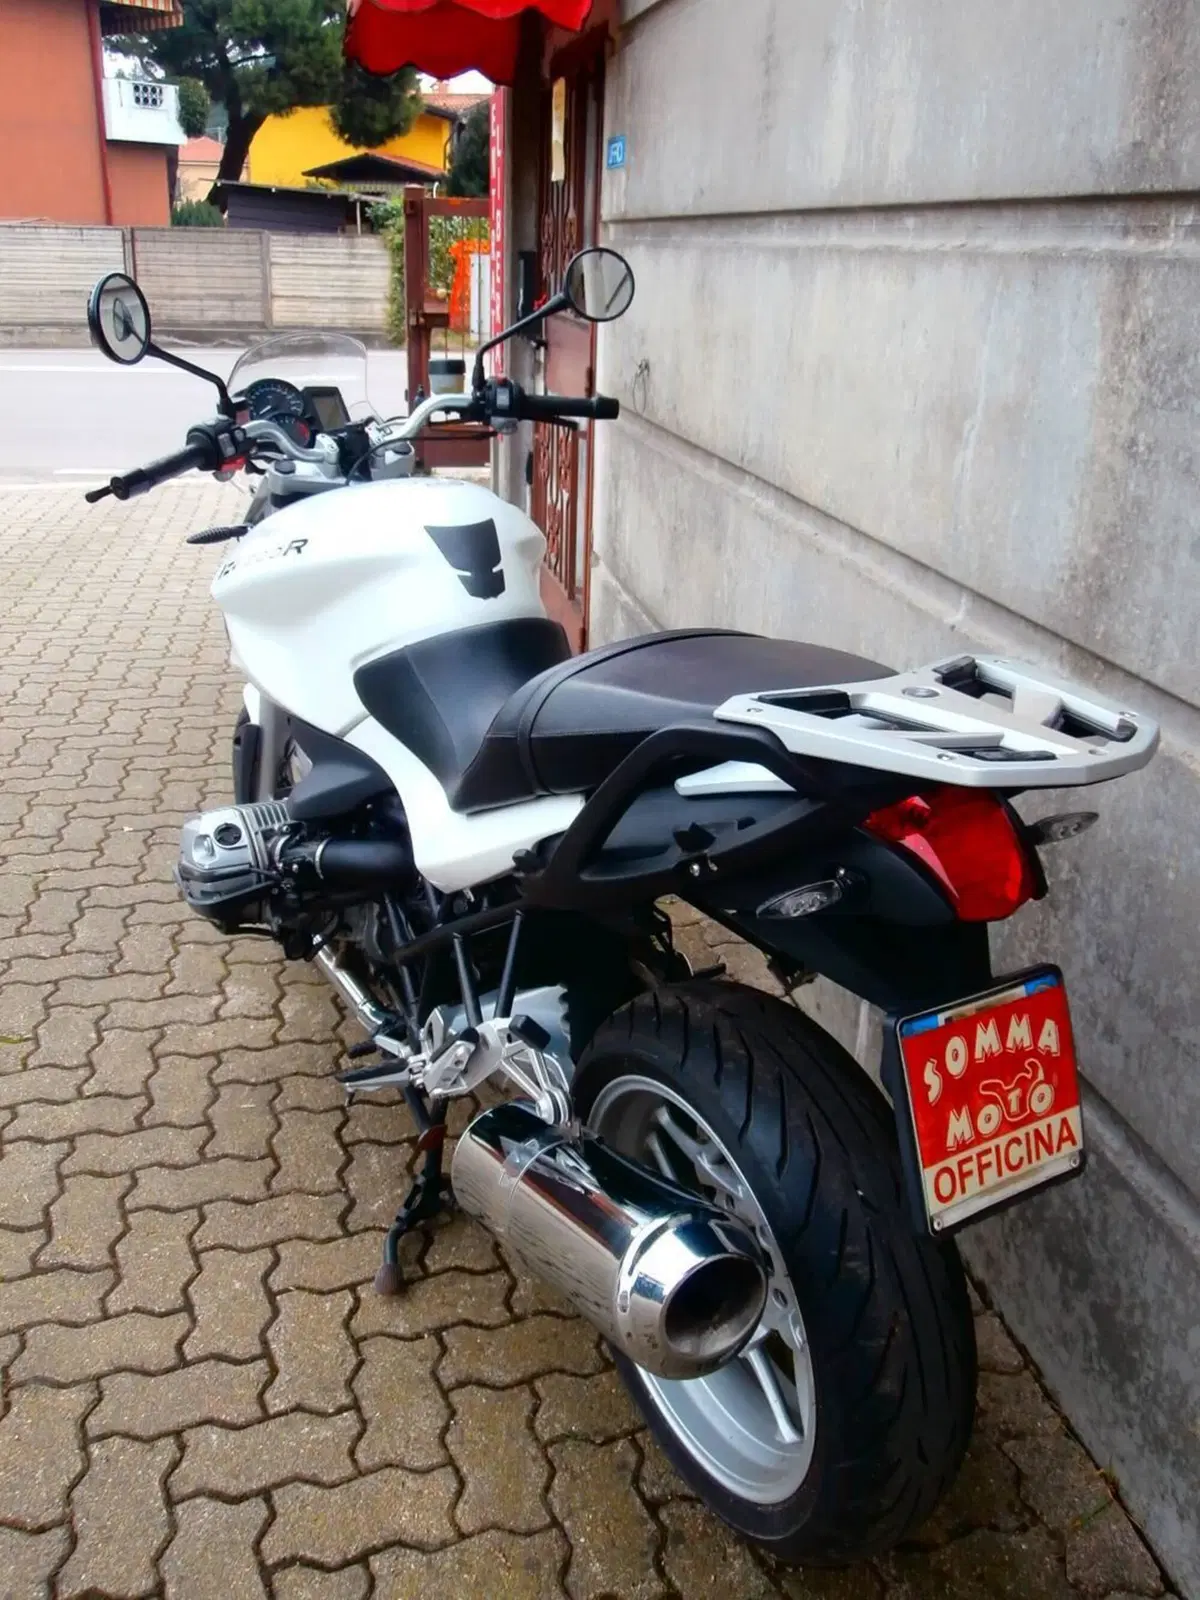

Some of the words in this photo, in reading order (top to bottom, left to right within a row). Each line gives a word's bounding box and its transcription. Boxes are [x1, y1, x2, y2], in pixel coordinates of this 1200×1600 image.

[923, 1013, 1061, 1106] SOMMA
[933, 1116, 1078, 1205] OFFICINA
[946, 1081, 1055, 1151] MOTO
